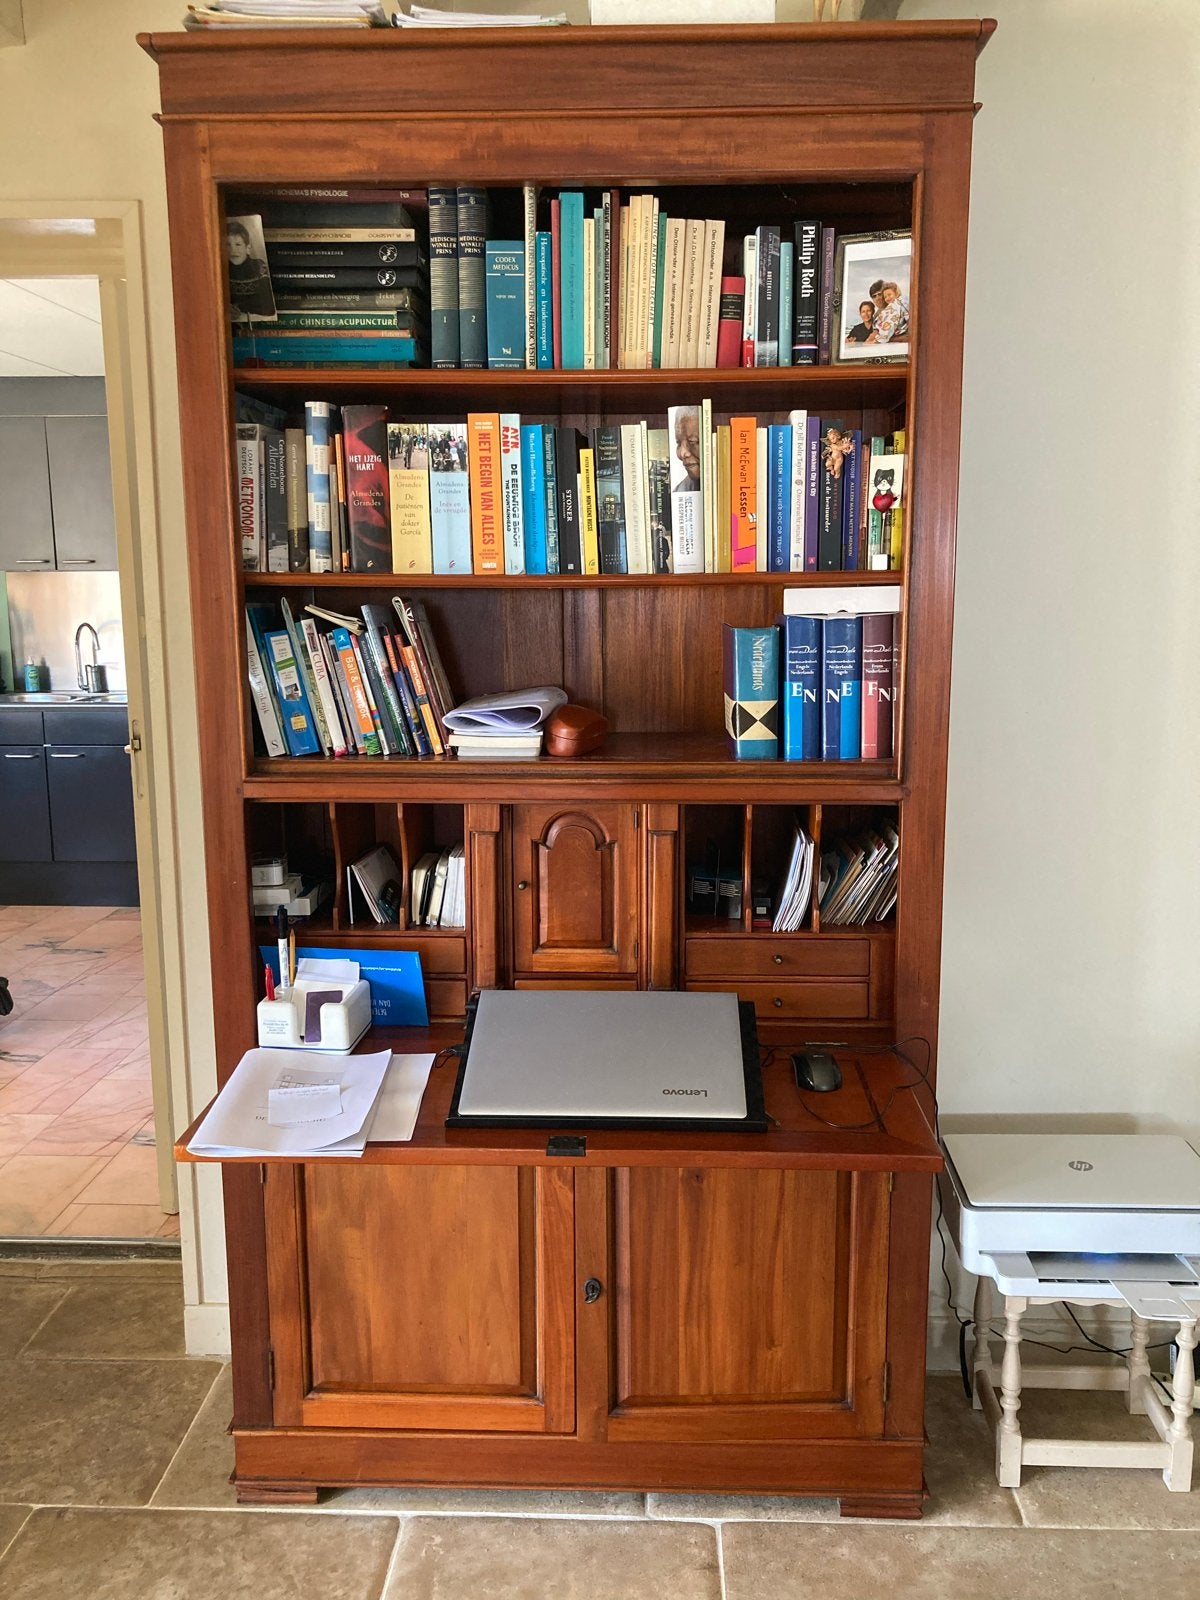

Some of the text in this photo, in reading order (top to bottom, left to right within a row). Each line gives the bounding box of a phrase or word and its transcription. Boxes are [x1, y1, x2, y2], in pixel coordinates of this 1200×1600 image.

[709, 241, 717, 270] Ottolander
[799, 226, 816, 298] Philip Roth
[539, 238, 548, 351] Homeopatische en kruidenrecepten
[339, 318, 398, 326] ACUPUNCTURE
[471, 315, 476, 323] 2
[478, 433, 492, 453] HET
[502, 426, 511, 455] RAND
[511, 427, 519, 449] AYN
[268, 445, 279, 489] Allerzielen
[350, 455, 382, 463] HET IJZIG
[357, 463, 374, 471] HART
[479, 456, 493, 488] BEGIN
[739, 430, 751, 518] Ian McEwan Lessen
[480, 491, 494, 511] VAN
[511, 464, 520, 519] DE EEUWIGE
[825, 486, 832, 495] de
[240, 477, 255, 540] METRONOME
[565, 489, 573, 522] STONER
[482, 514, 495, 545] ALLES
[777, 526, 782, 534] OP
[248, 651, 261, 681] Heerlijk
[312, 654, 326, 681] CUBA
[345, 656, 358, 674] Bali
[752, 635, 766, 691] Nederlands
[410, 660, 422, 693] PORTUGAL
[792, 682, 817, 703] E N
[826, 682, 853, 703] N E
[868, 682, 891, 702] F N
[662, 1089, 708, 1098] Lenovo
[1070, 1160, 1092, 1171] hp
